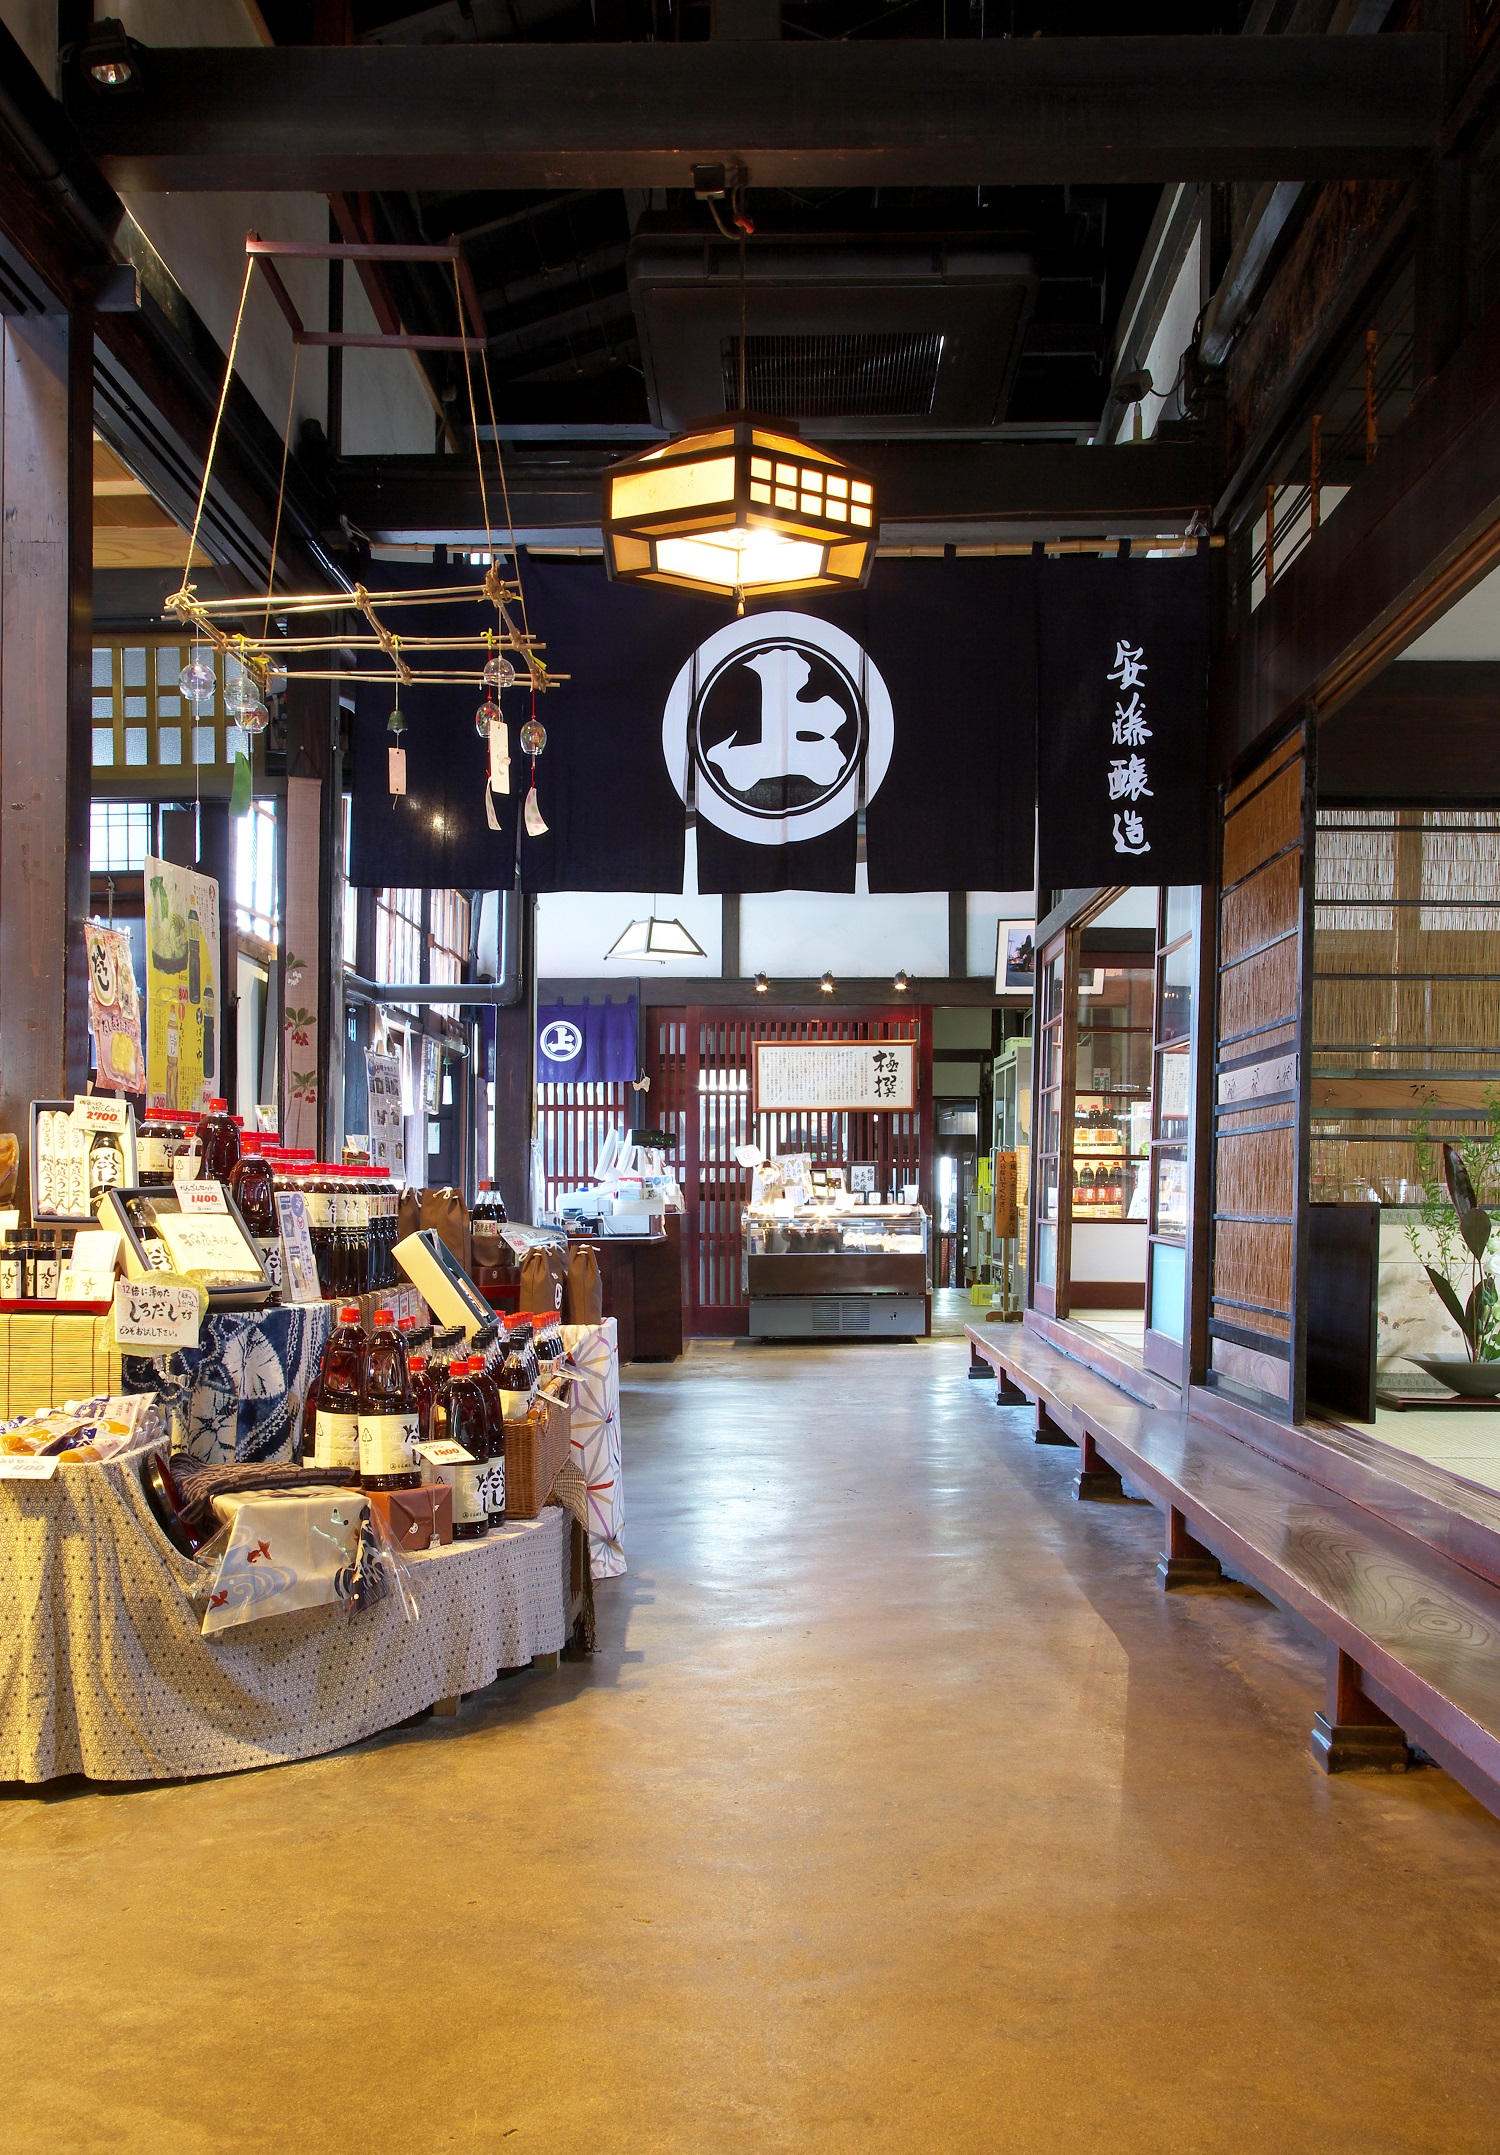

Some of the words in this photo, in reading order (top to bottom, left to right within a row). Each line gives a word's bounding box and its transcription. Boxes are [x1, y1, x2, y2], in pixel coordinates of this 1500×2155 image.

[706, 648, 848, 792] 上
[1106, 639, 1154, 855] 安藤醸造
